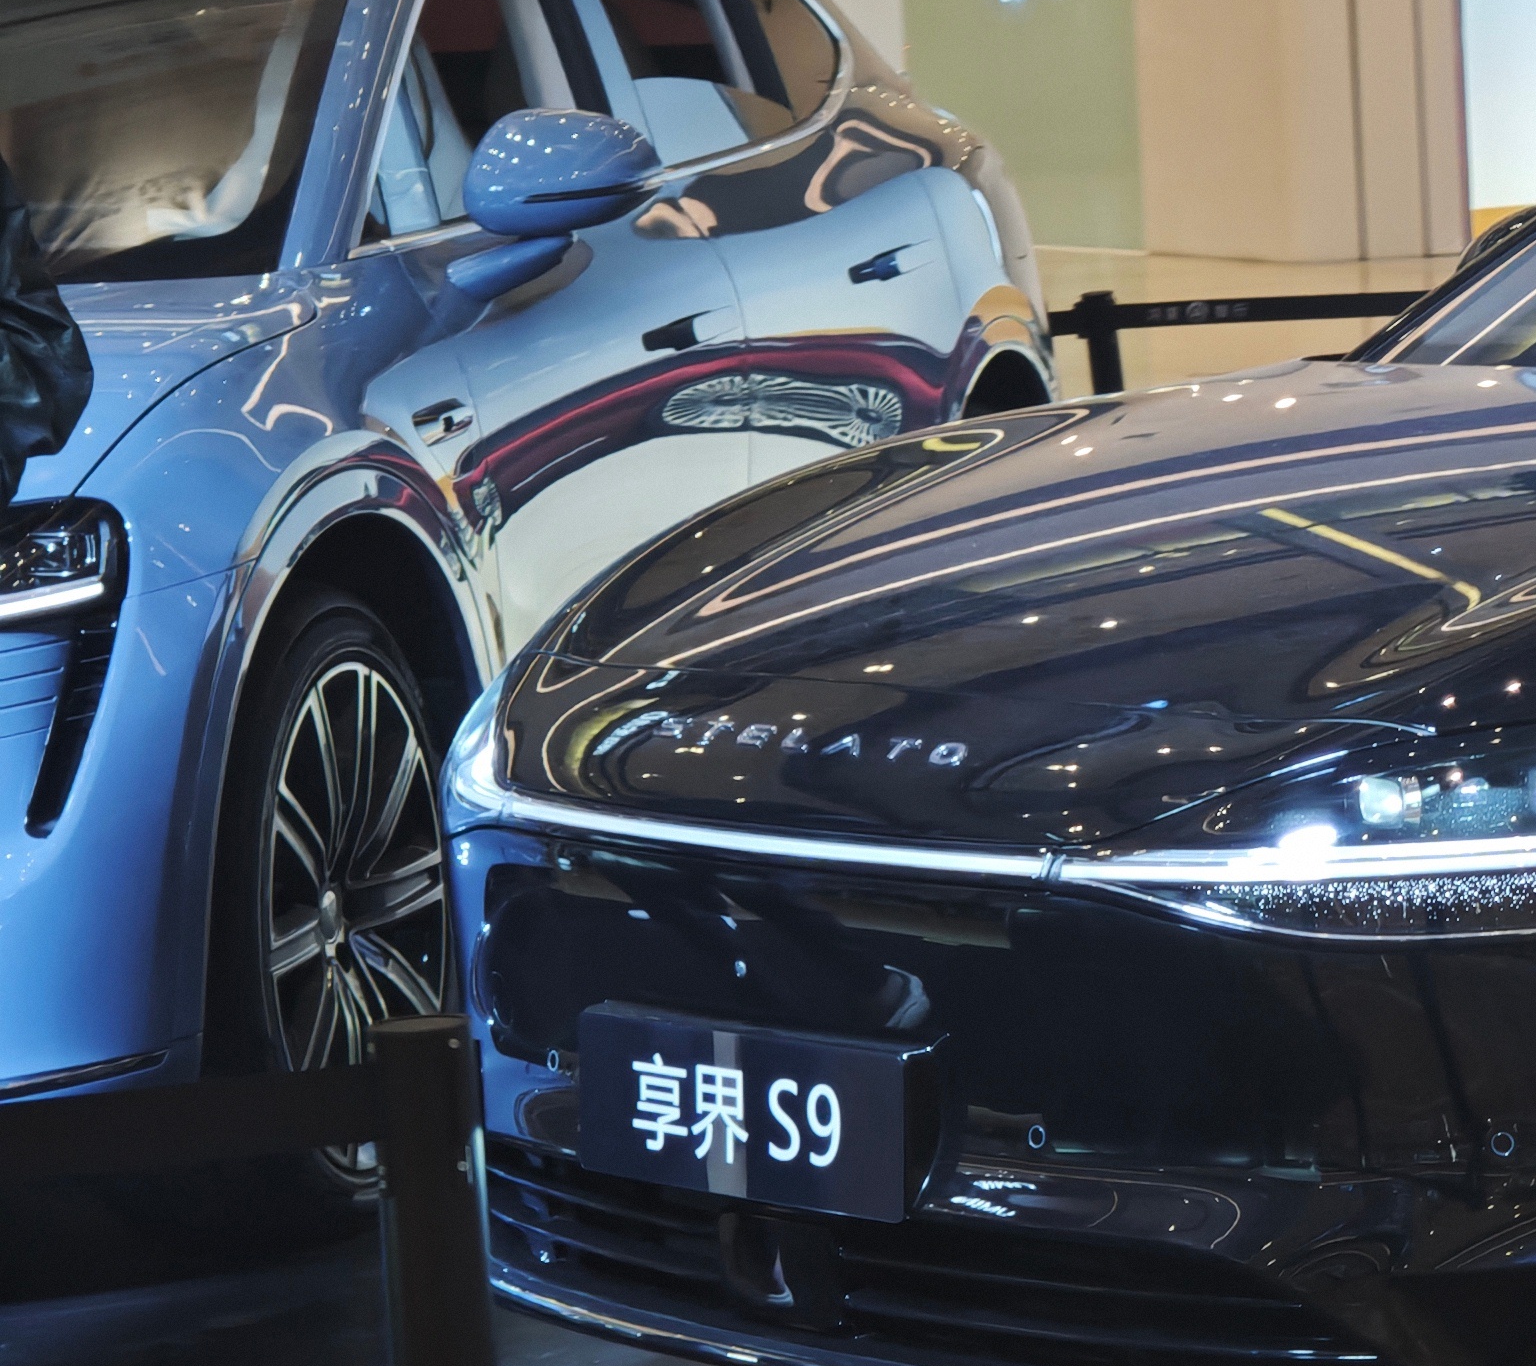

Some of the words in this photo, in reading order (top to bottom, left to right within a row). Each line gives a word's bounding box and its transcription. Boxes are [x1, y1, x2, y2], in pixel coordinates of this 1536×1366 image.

[652, 714, 968, 766] STELATO
[631, 1051, 749, 1165] 享界
[767, 1077, 841, 1168] S9
